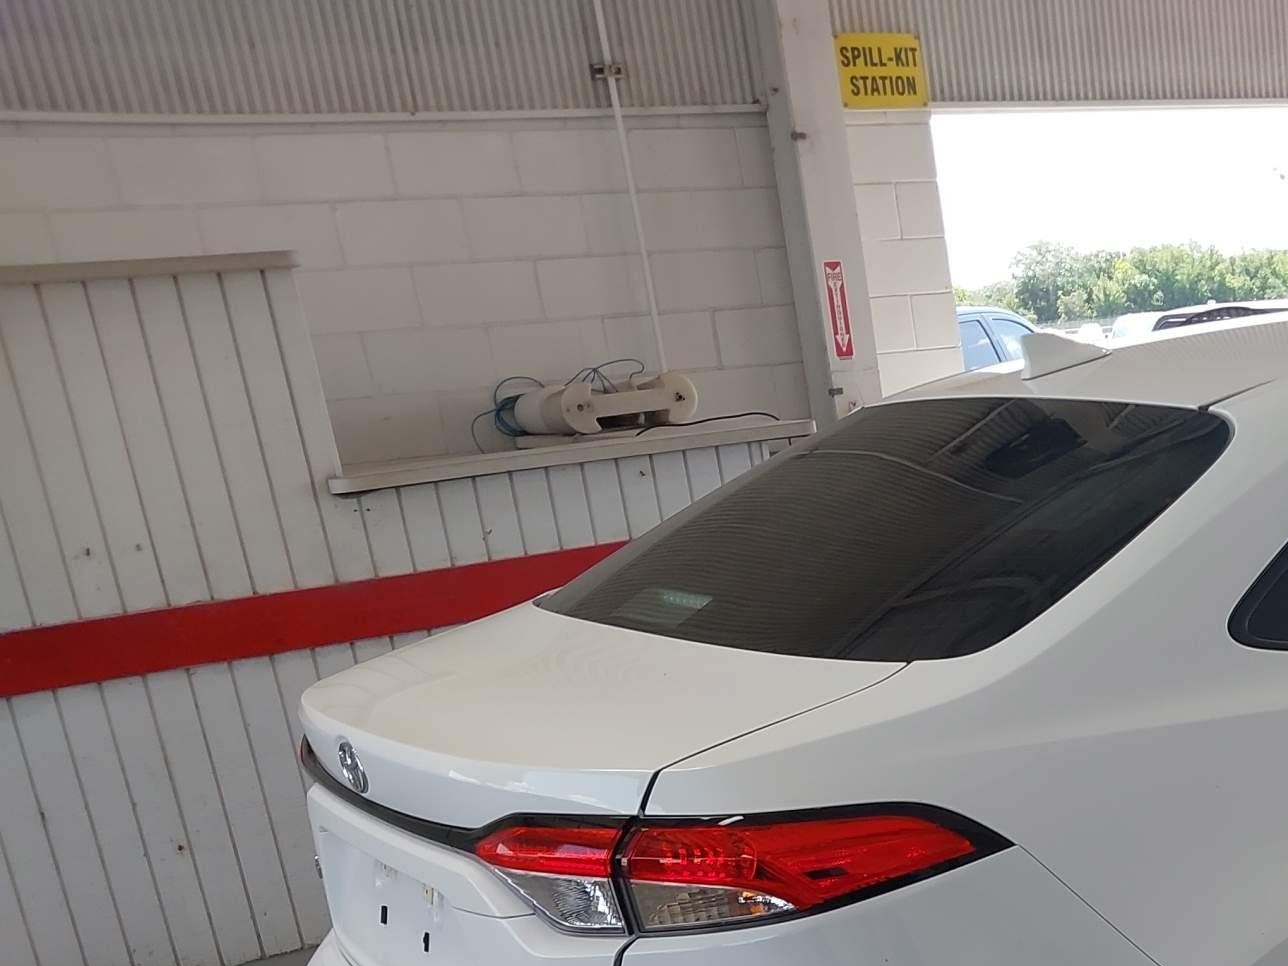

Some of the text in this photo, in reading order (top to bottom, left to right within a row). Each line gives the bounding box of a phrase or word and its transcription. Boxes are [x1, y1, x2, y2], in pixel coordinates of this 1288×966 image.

[839, 46, 917, 68] SPILL-KIT
[850, 75, 918, 97] STATION
[827, 272, 843, 281] FIRE
